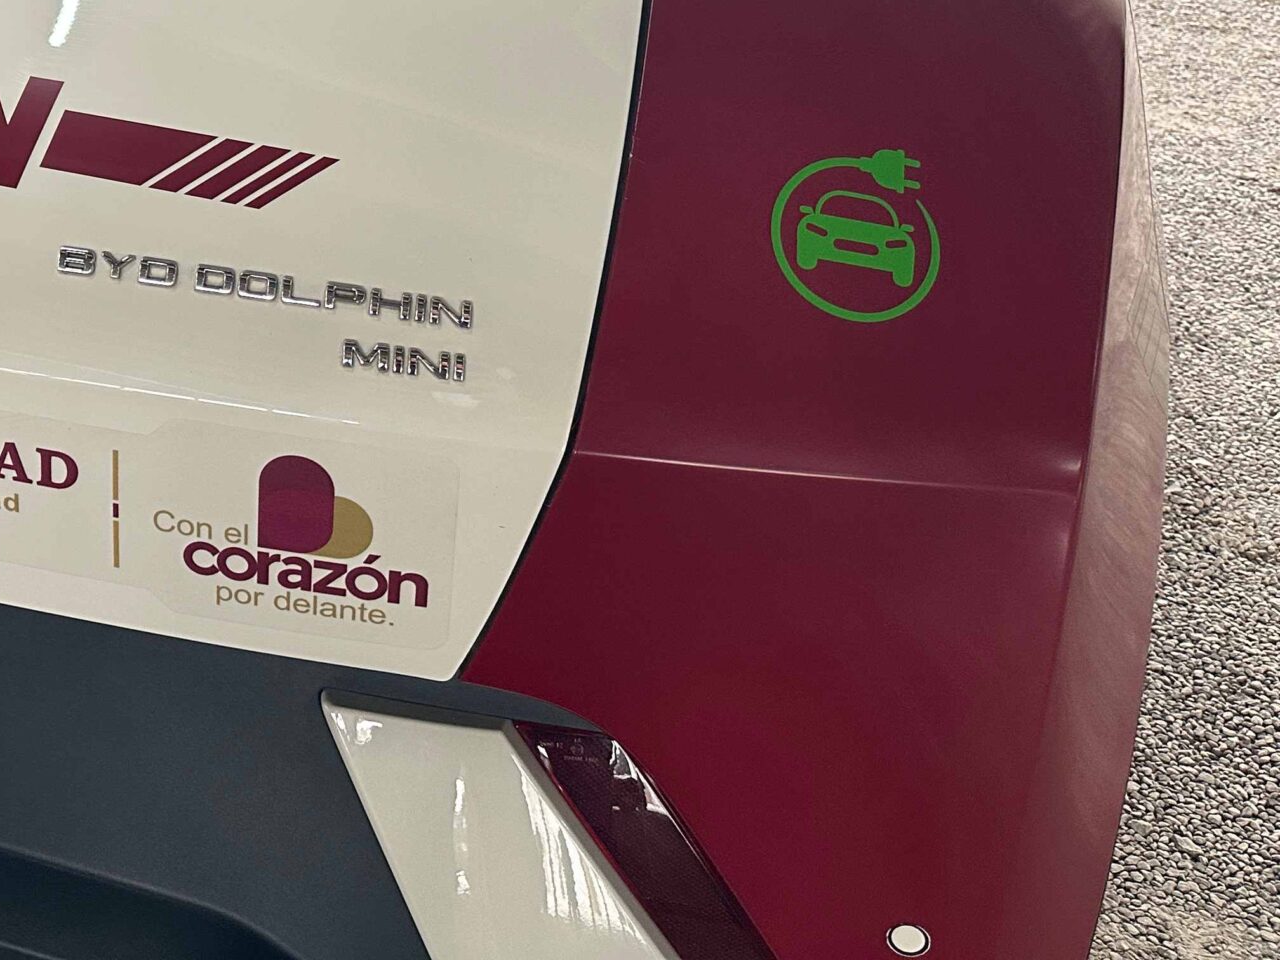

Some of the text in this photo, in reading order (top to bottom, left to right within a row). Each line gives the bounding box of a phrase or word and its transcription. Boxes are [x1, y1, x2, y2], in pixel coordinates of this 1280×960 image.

[57, 245, 474, 329] BYD DOLPHIN
[341, 338, 466, 382] MINI
[153, 510, 249, 545] Con el
[183, 541, 429, 608] corazón
[216, 585, 394, 627] por delante.
